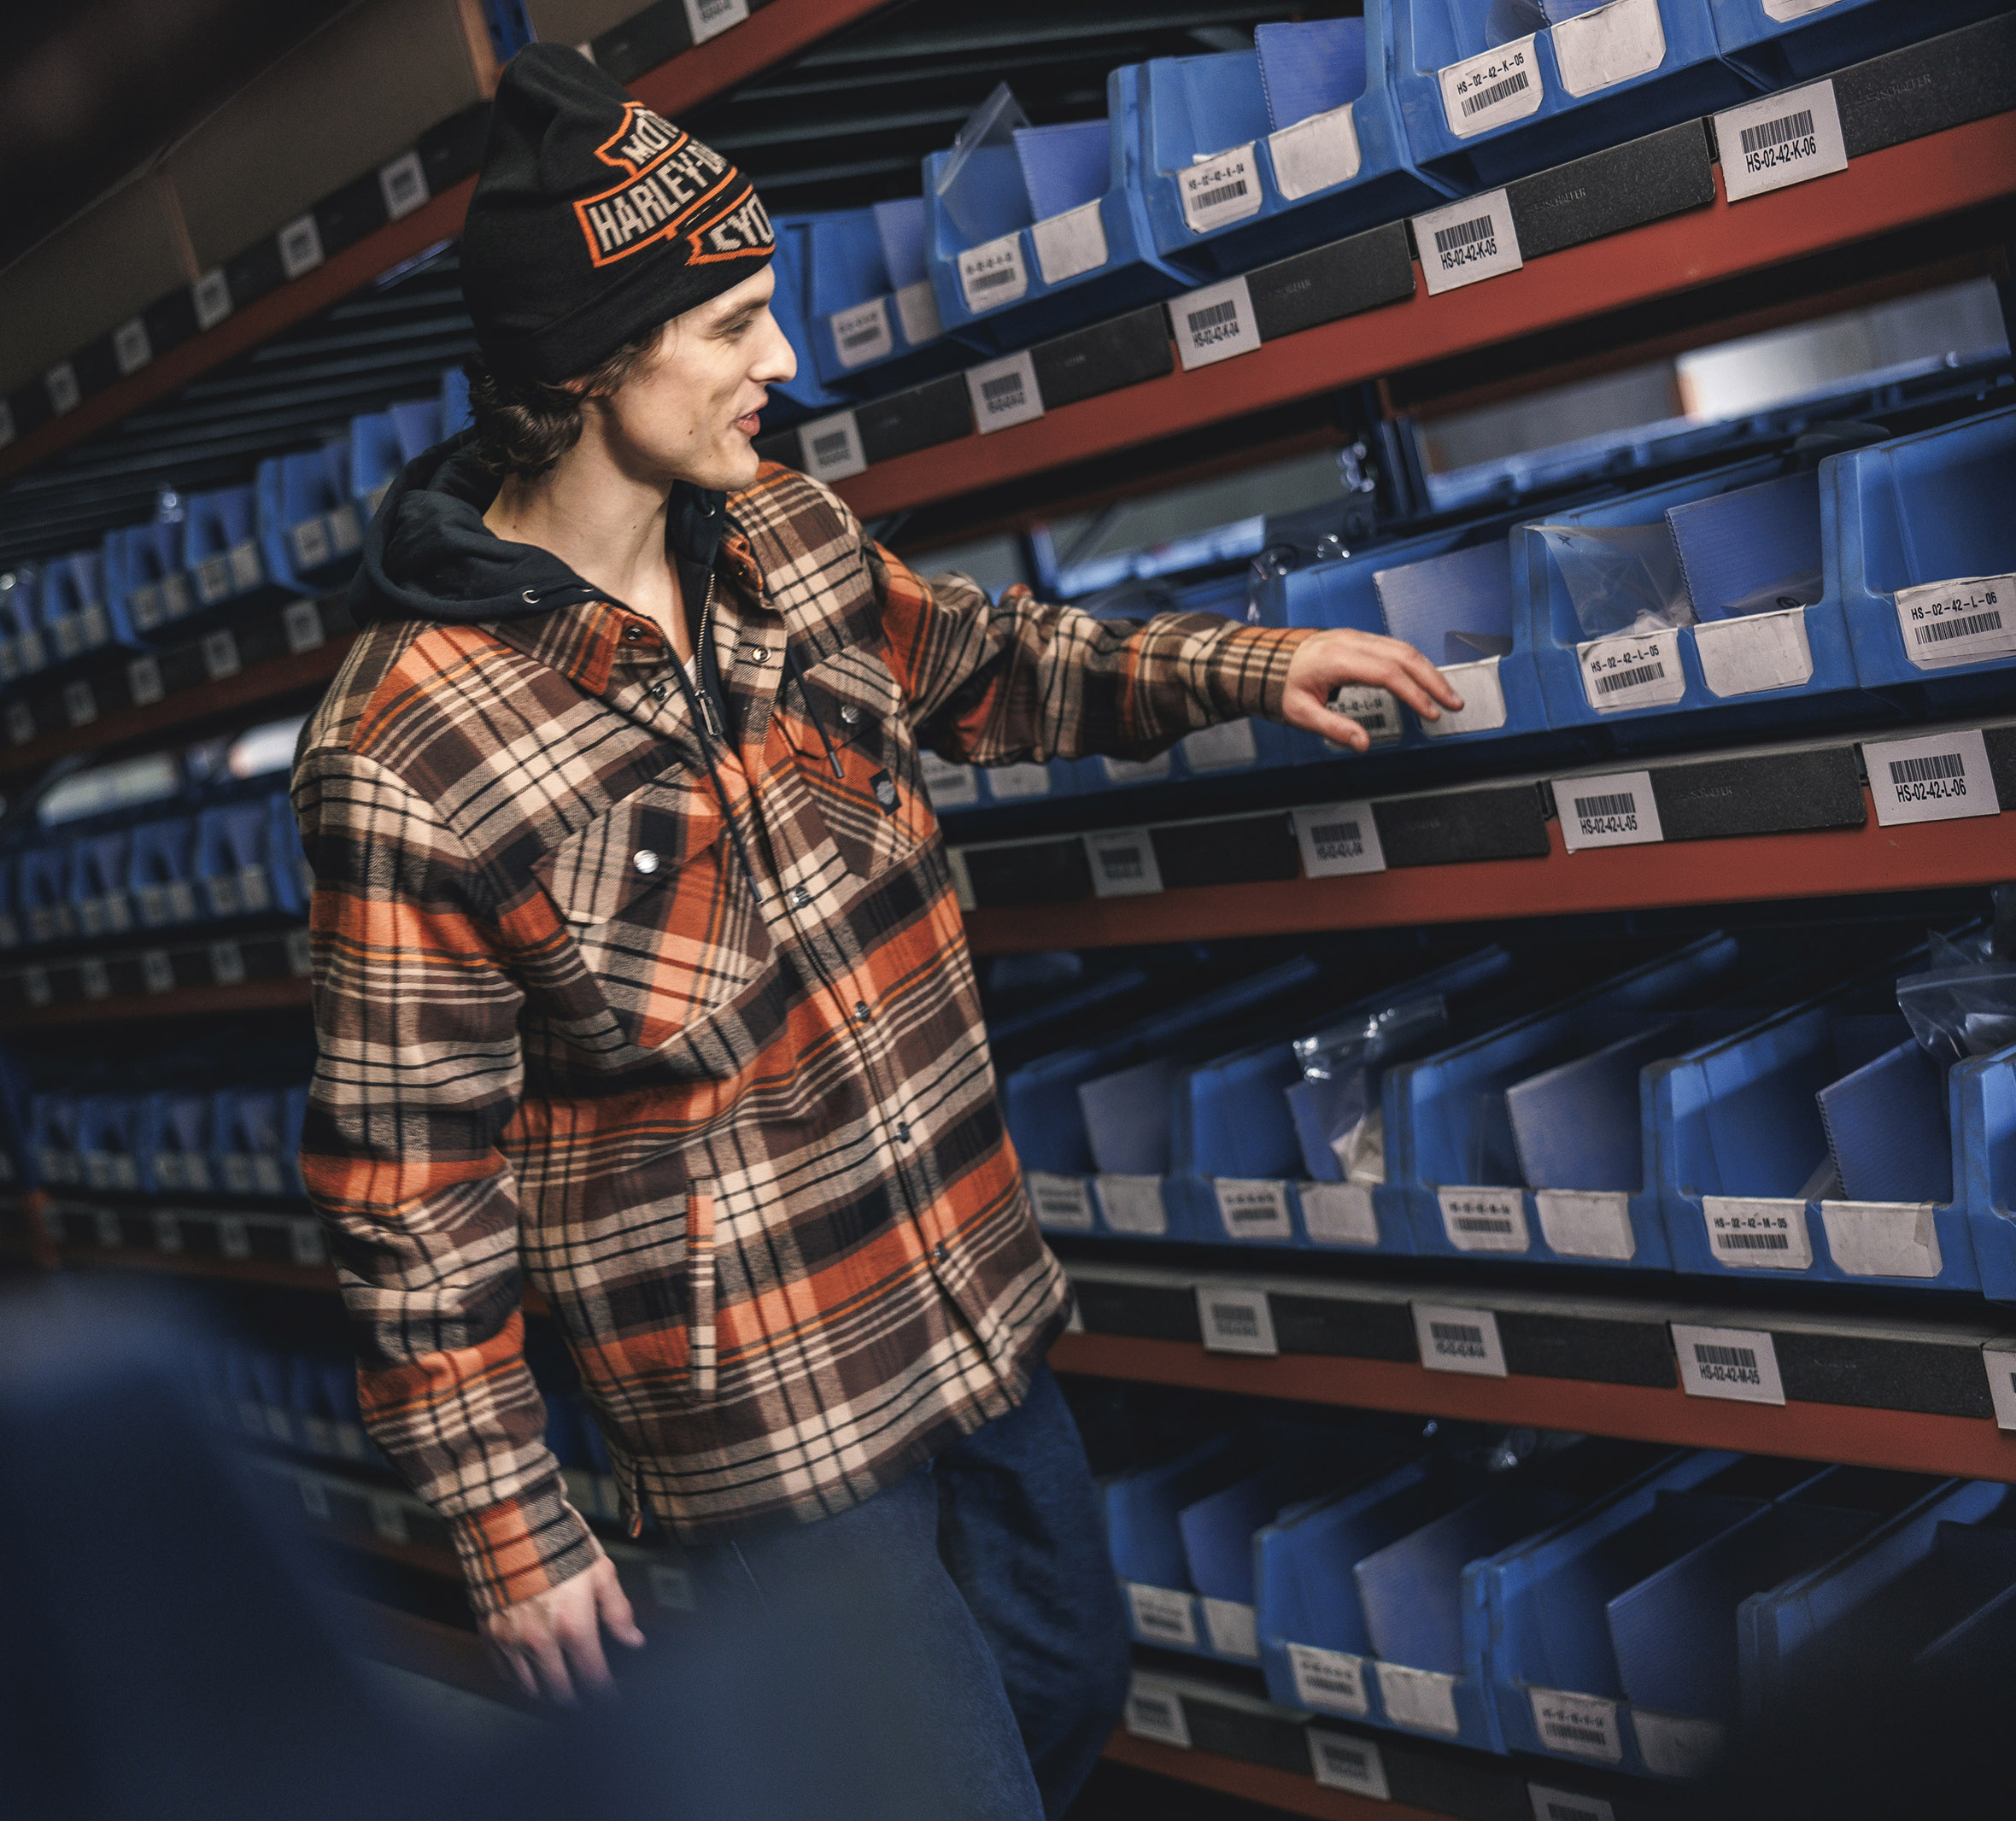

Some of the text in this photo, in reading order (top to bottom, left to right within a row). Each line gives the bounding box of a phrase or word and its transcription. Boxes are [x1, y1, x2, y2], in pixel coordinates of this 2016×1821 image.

[1745, 136, 1817, 173] HS-02-42-K-06
[1440, 237, 1497, 271] HS-02-42-K-05
[1896, 777, 1966, 803] HS-02-42-L-06
[1579, 815, 1638, 835] HS-02-42-L-05
[1698, 1364, 1761, 1385] HS-02-42-M-05
